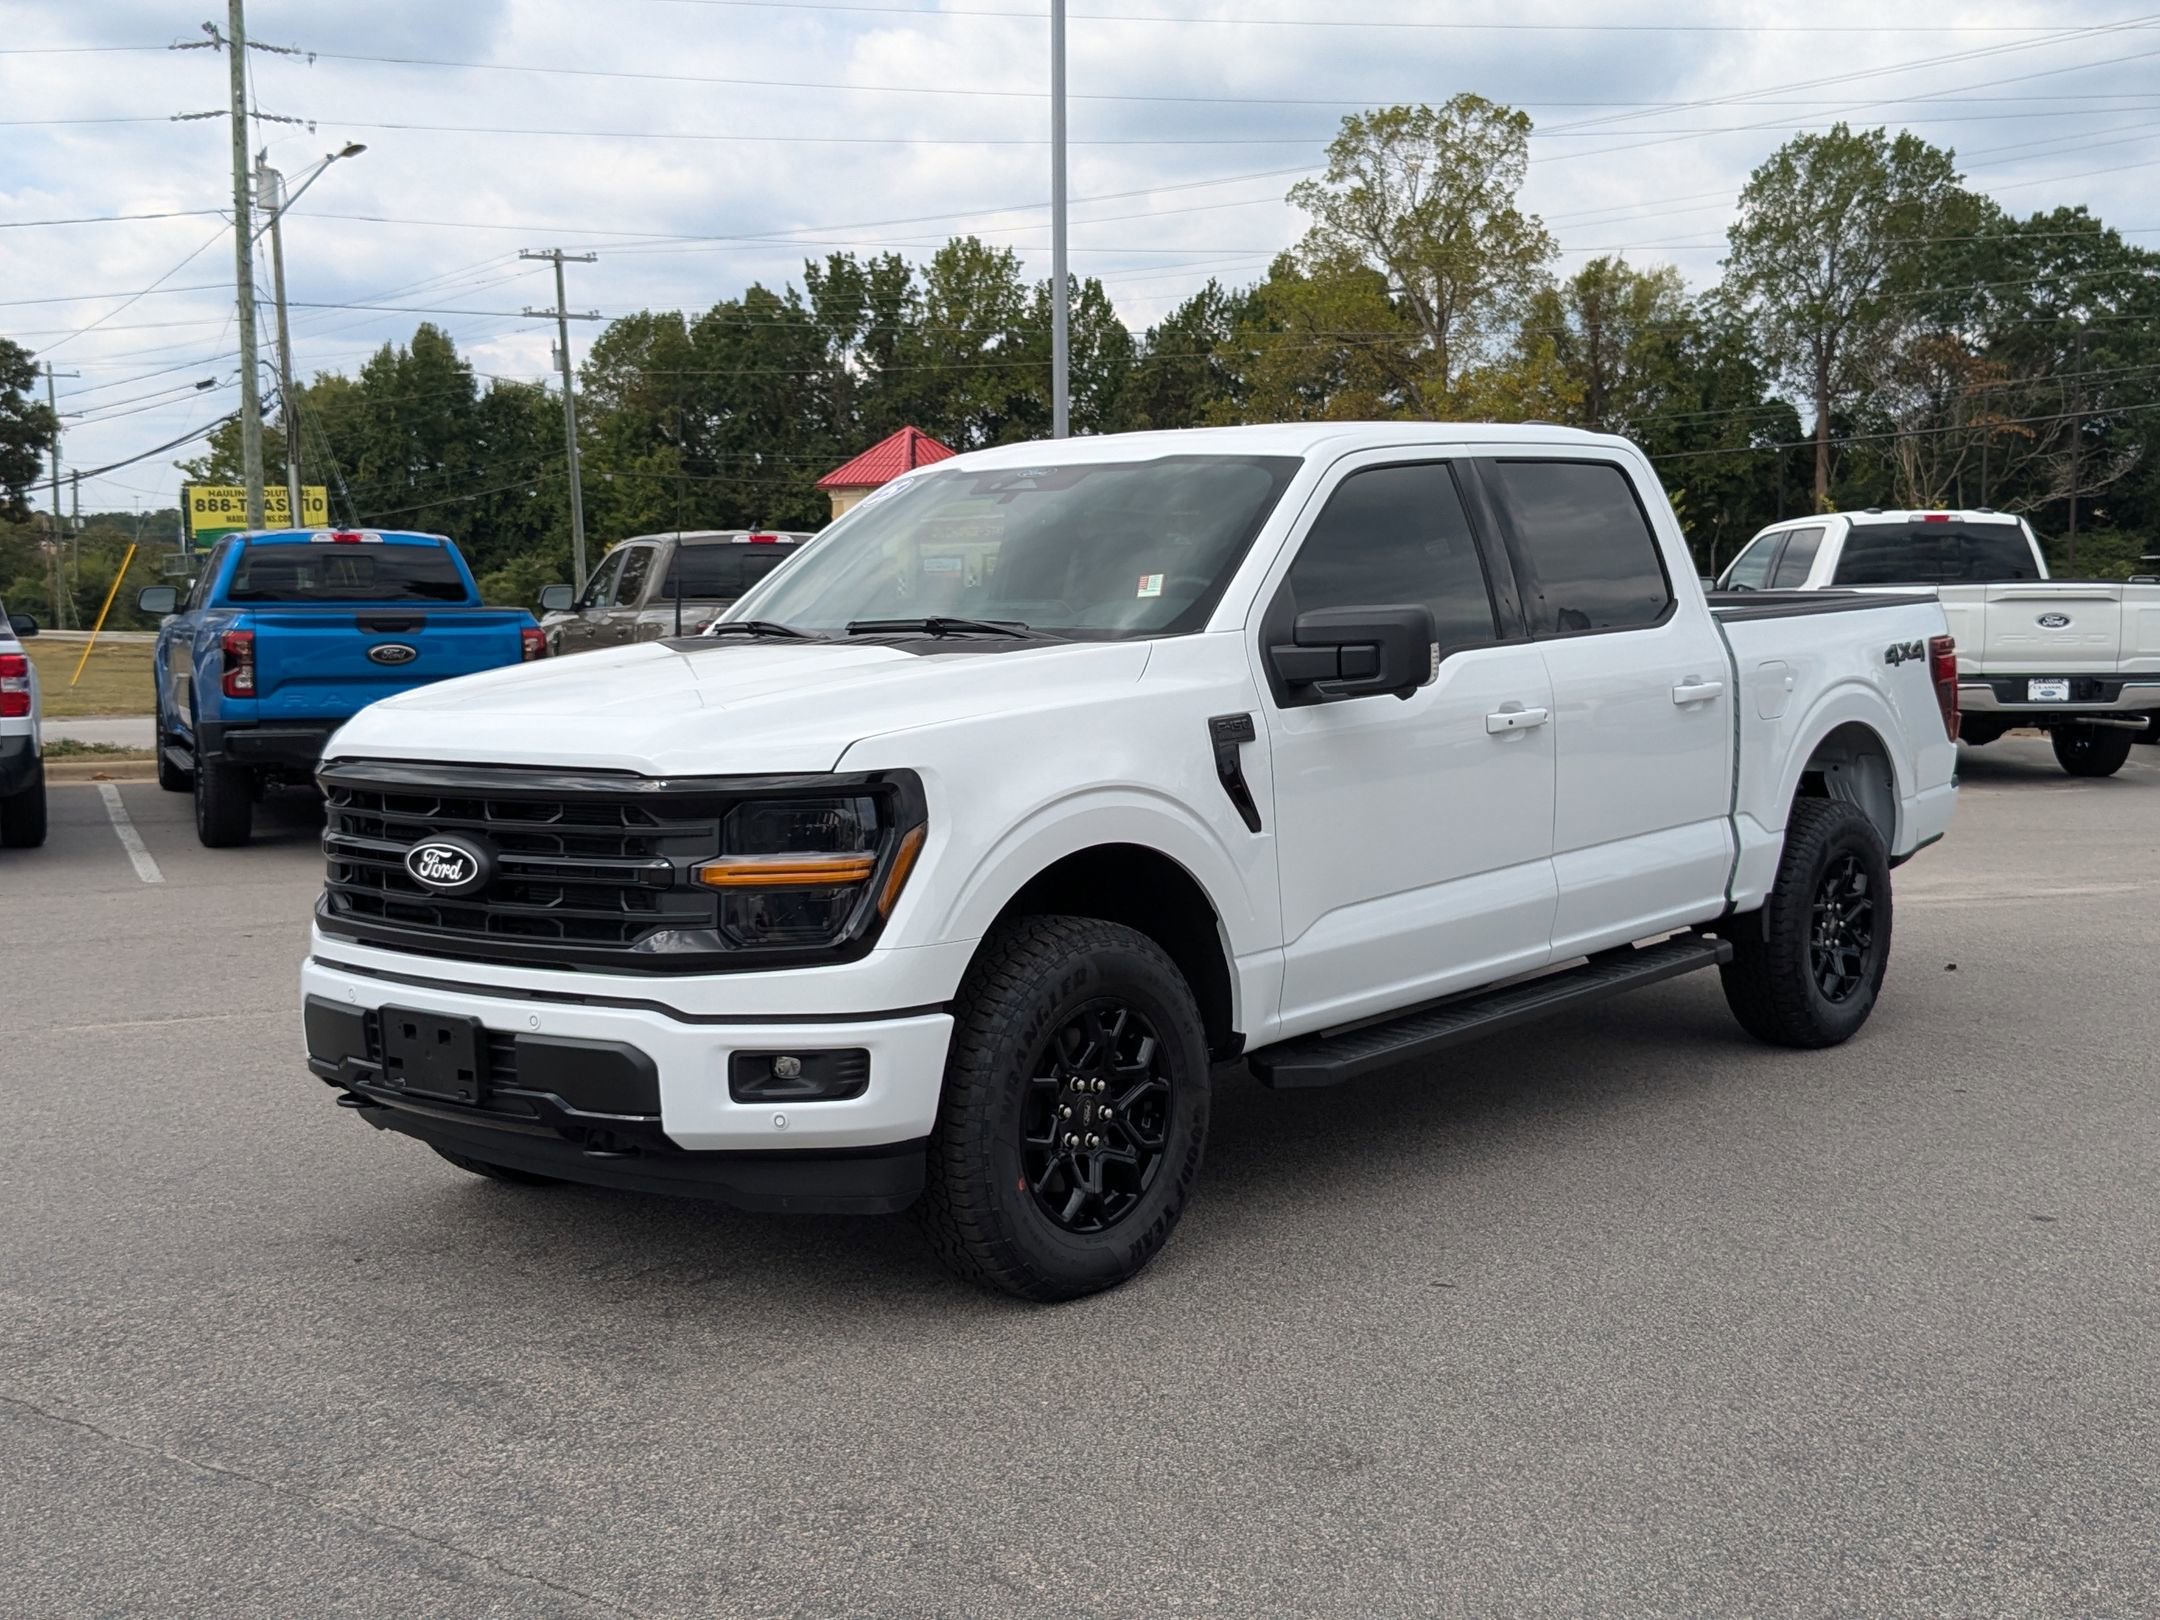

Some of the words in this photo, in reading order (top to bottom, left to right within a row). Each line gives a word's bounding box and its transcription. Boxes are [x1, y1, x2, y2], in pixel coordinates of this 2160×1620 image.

[208, 489, 247, 498] HAULIN
[261, 489, 311, 498] OLUTS
[195, 498, 323, 513] 888-TAS10
[381, 648, 406, 660] Ford
[419, 848, 464, 880] Ford
